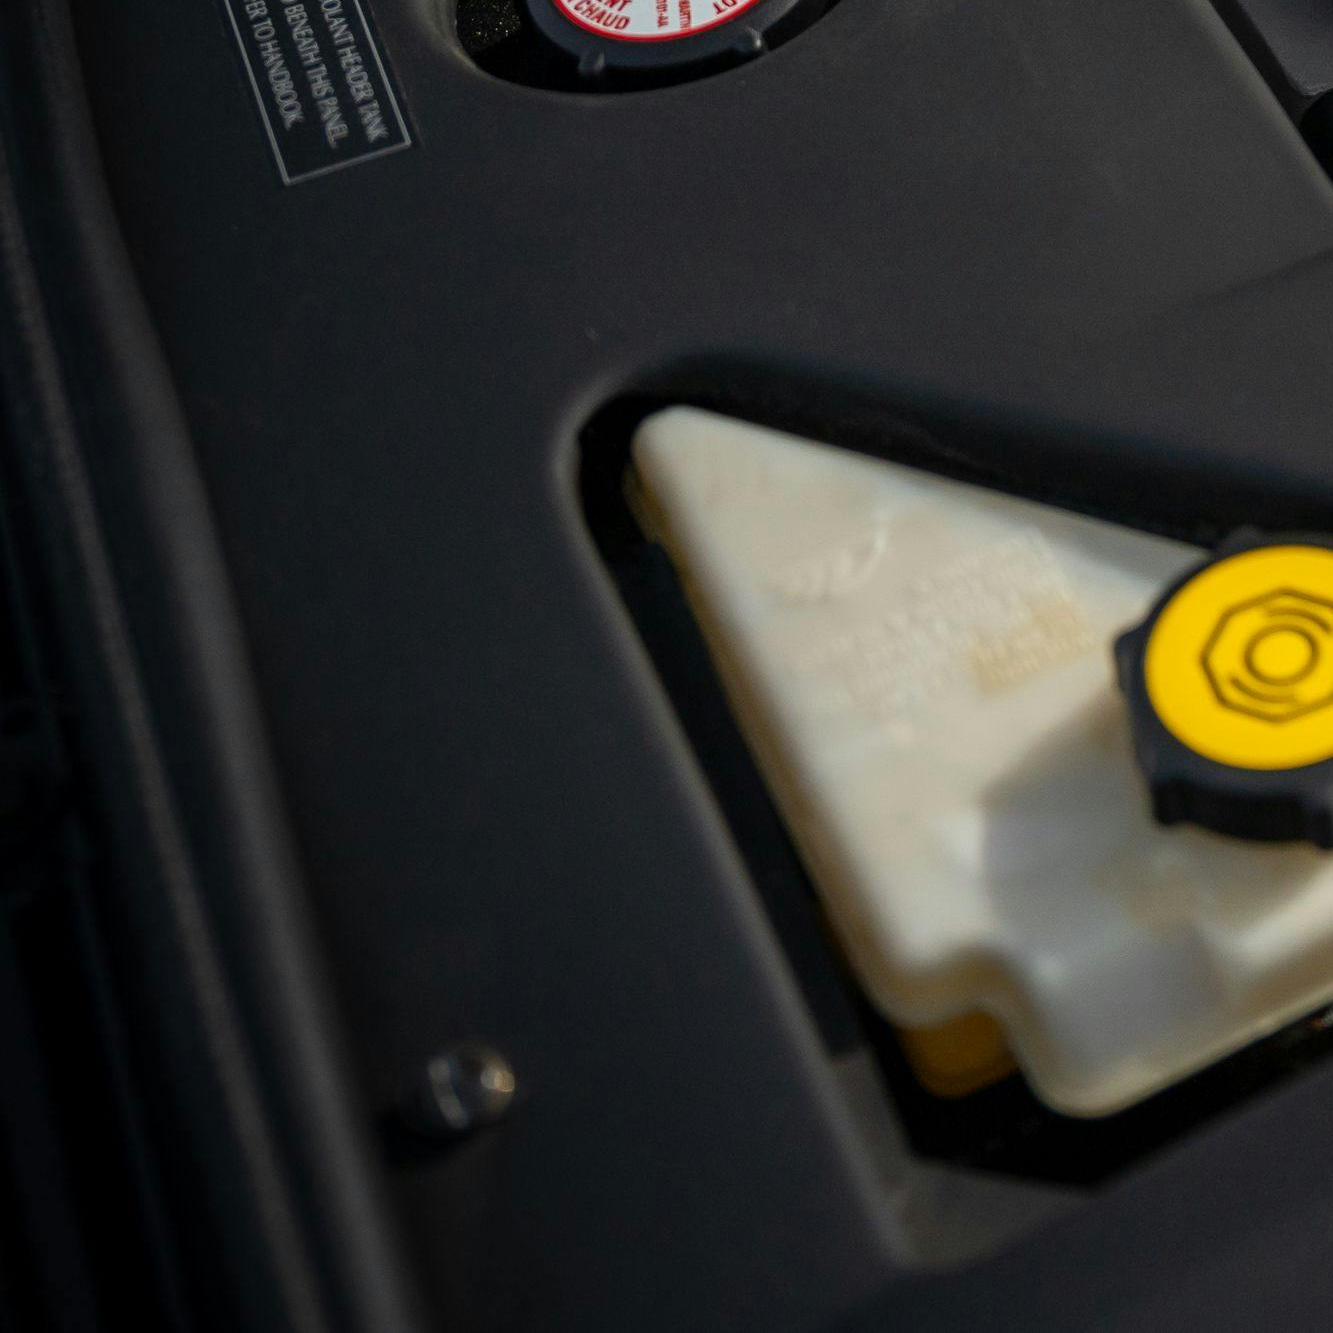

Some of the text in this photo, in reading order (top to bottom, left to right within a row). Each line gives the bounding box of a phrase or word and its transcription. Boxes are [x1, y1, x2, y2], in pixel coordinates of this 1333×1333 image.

[253, 18, 276, 40] TO
[284, 4, 323, 71] BENEATH
[307, 63, 335, 99] THIS
[339, 44, 375, 103] HEADER
[358, 102, 389, 144] TANK
